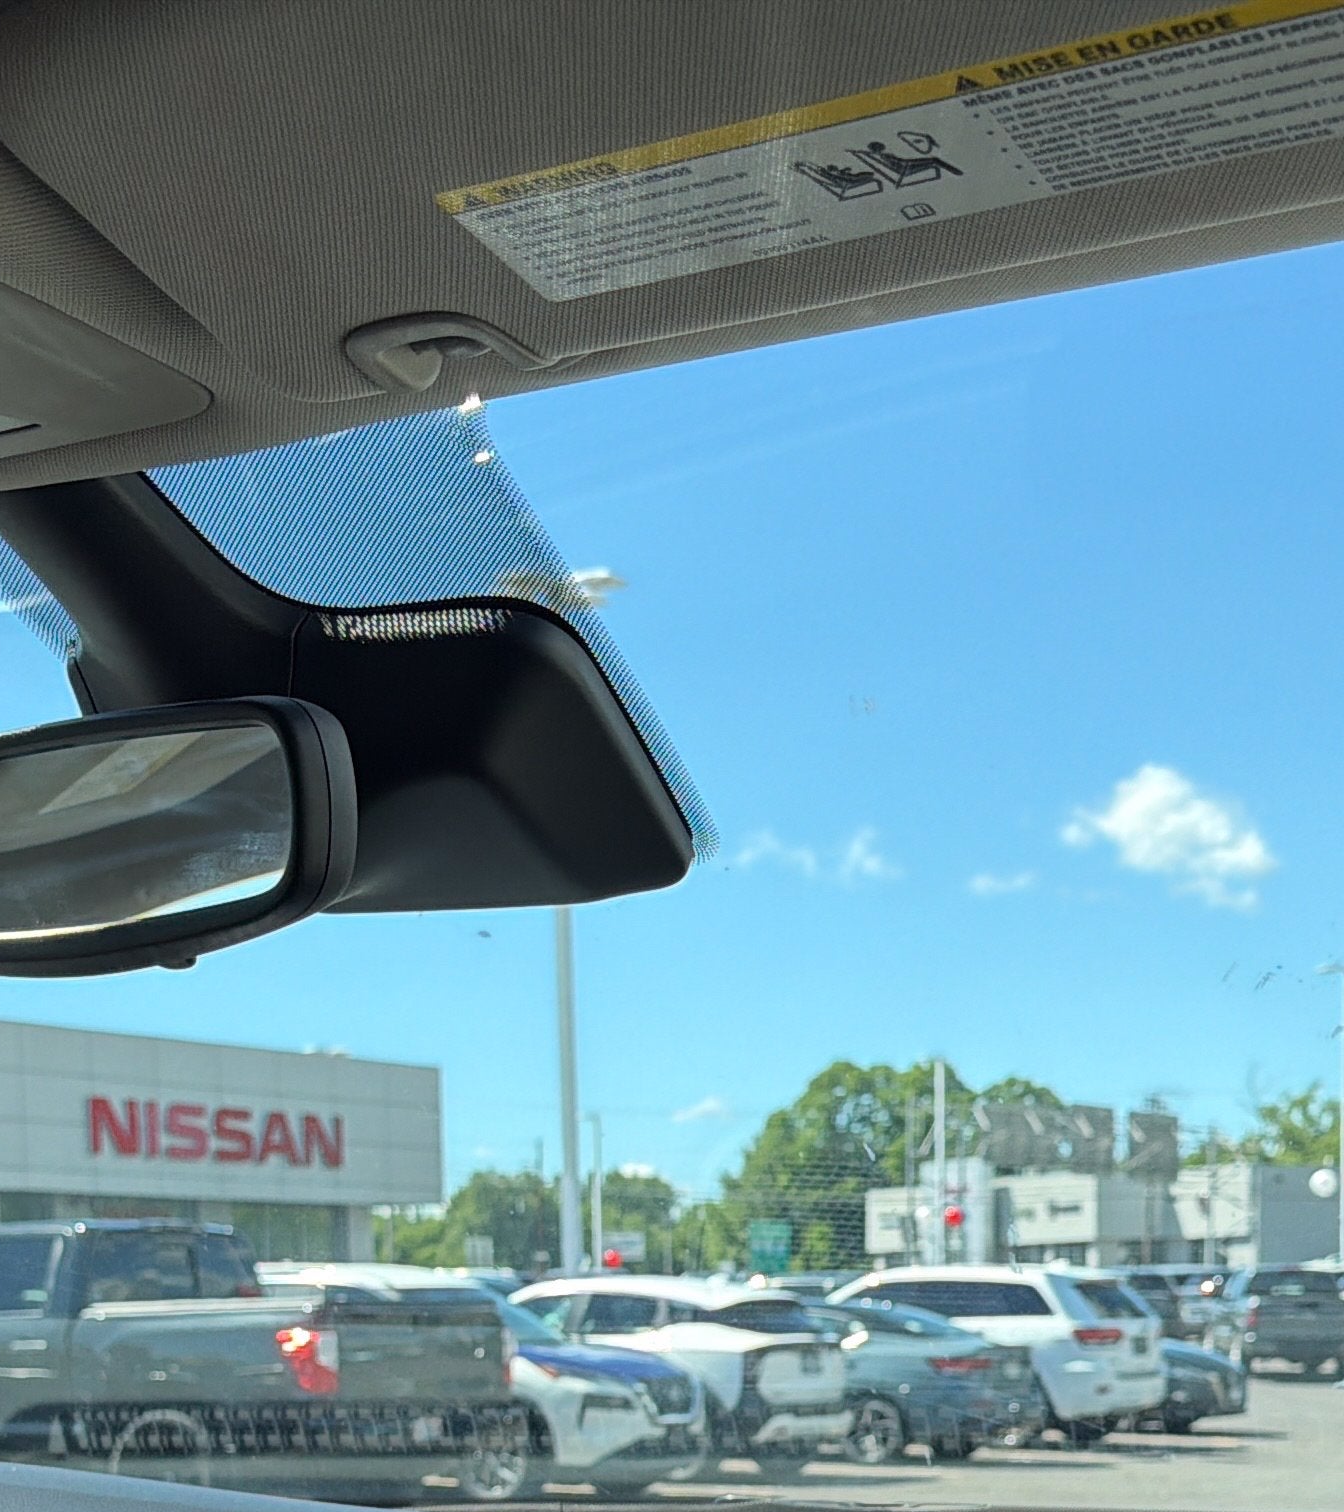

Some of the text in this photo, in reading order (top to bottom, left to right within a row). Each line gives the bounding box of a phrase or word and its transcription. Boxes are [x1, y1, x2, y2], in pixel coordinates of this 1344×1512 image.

[992, 12, 1236, 81] MISE EN GARDE
[1099, 60, 1145, 75] SACS
[88, 1095, 344, 1168] NISSAN
